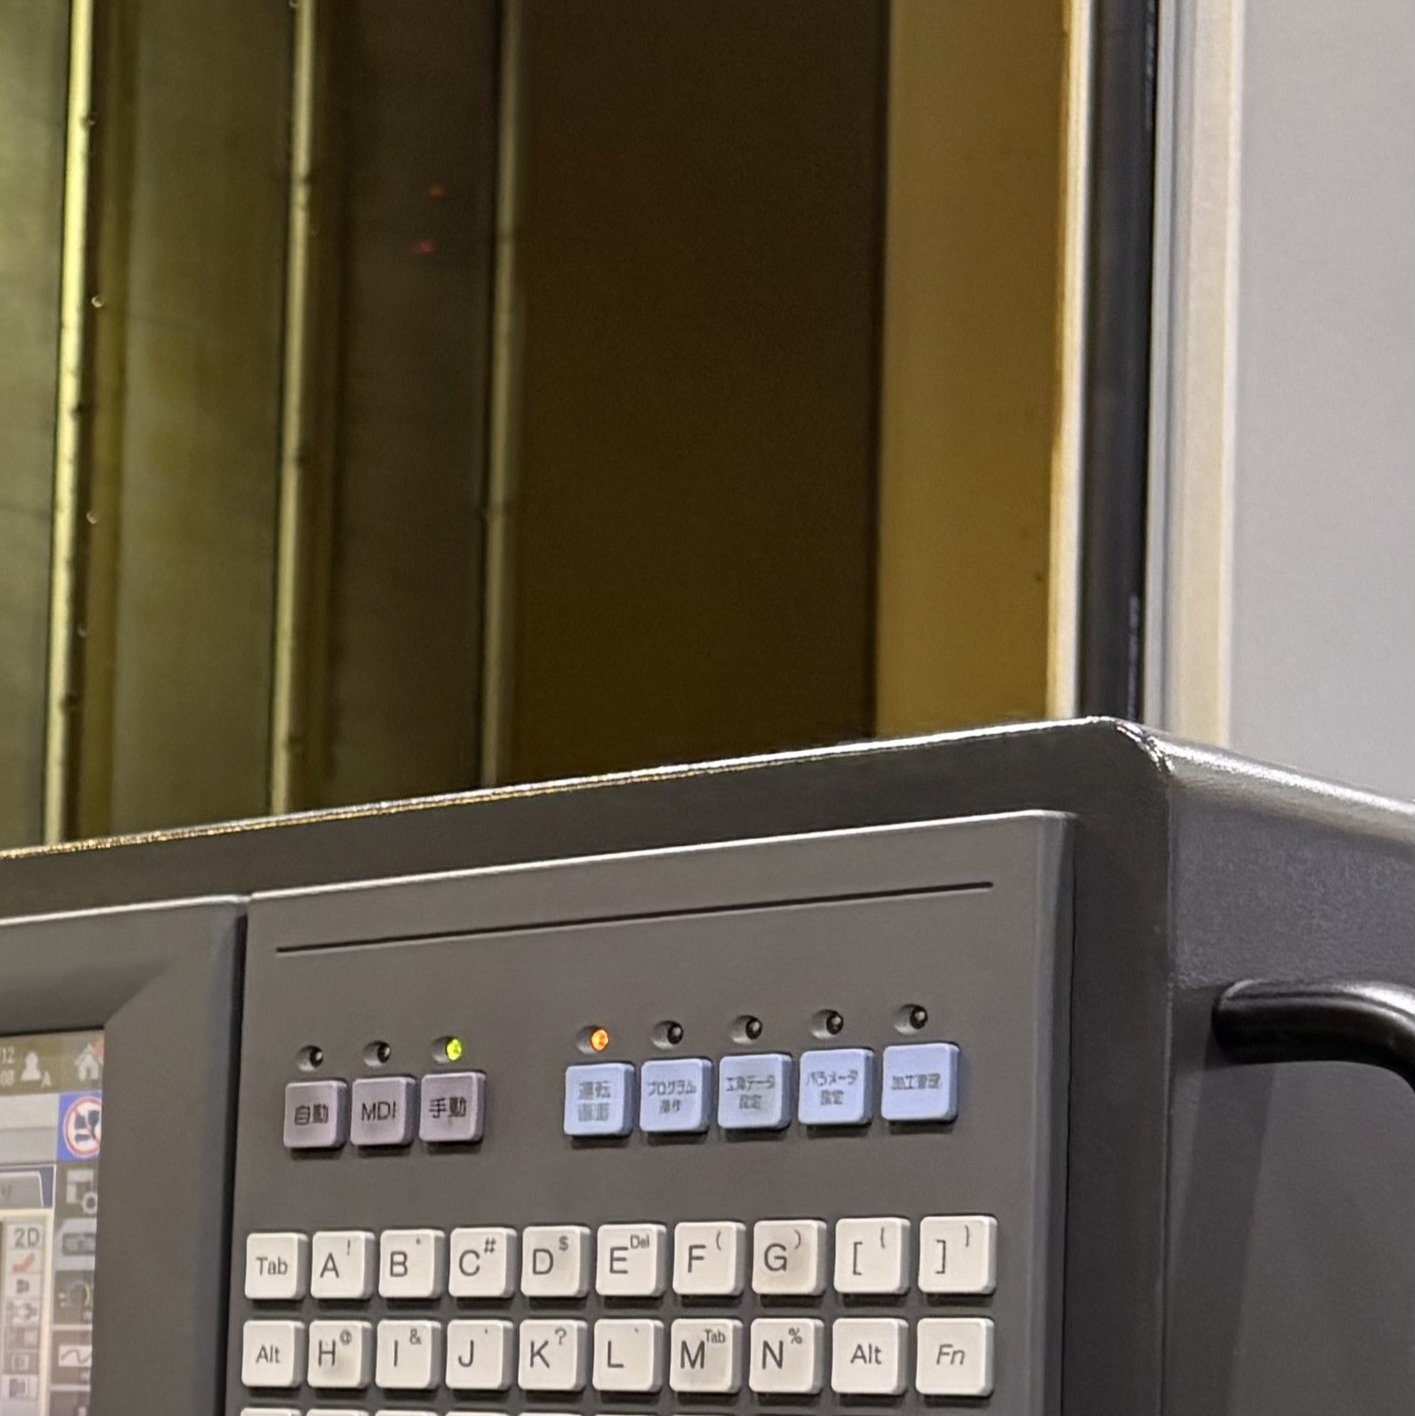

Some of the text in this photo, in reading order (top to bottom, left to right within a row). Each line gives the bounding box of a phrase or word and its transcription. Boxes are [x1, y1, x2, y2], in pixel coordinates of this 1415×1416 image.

[648, 1080, 697, 1096] プログラム
[806, 1070, 859, 1087] パラメータ
[294, 1104, 329, 1126] 自動
[361, 1101, 396, 1121] MDI
[429, 1097, 467, 1118] 手動
[15, 1228, 40, 1247] 2D
[256, 1256, 288, 1275] Tab
[320, 1253, 340, 1278] A
[389, 1251, 409, 1277] B
[459, 1238, 496, 1277] C #
[532, 1235, 569, 1275] D $
[609, 1234, 650, 1274] E Del
[687, 1244, 707, 1273] F
[763, 1243, 788, 1272] G
[852, 1241, 863, 1275] [
[935, 1239, 946, 1274] ]
[409, 1328, 421, 1345] &
[529, 1327, 567, 1369] K ?
[680, 1328, 726, 1369] M Tab
[761, 1327, 803, 1370] N %
[255, 1345, 281, 1364] Alt
[318, 1339, 336, 1366] H
[458, 1340, 475, 1368] J
[607, 1340, 624, 1368] L
[850, 1344, 882, 1365] Alt
[935, 1343, 966, 1366] Fn
